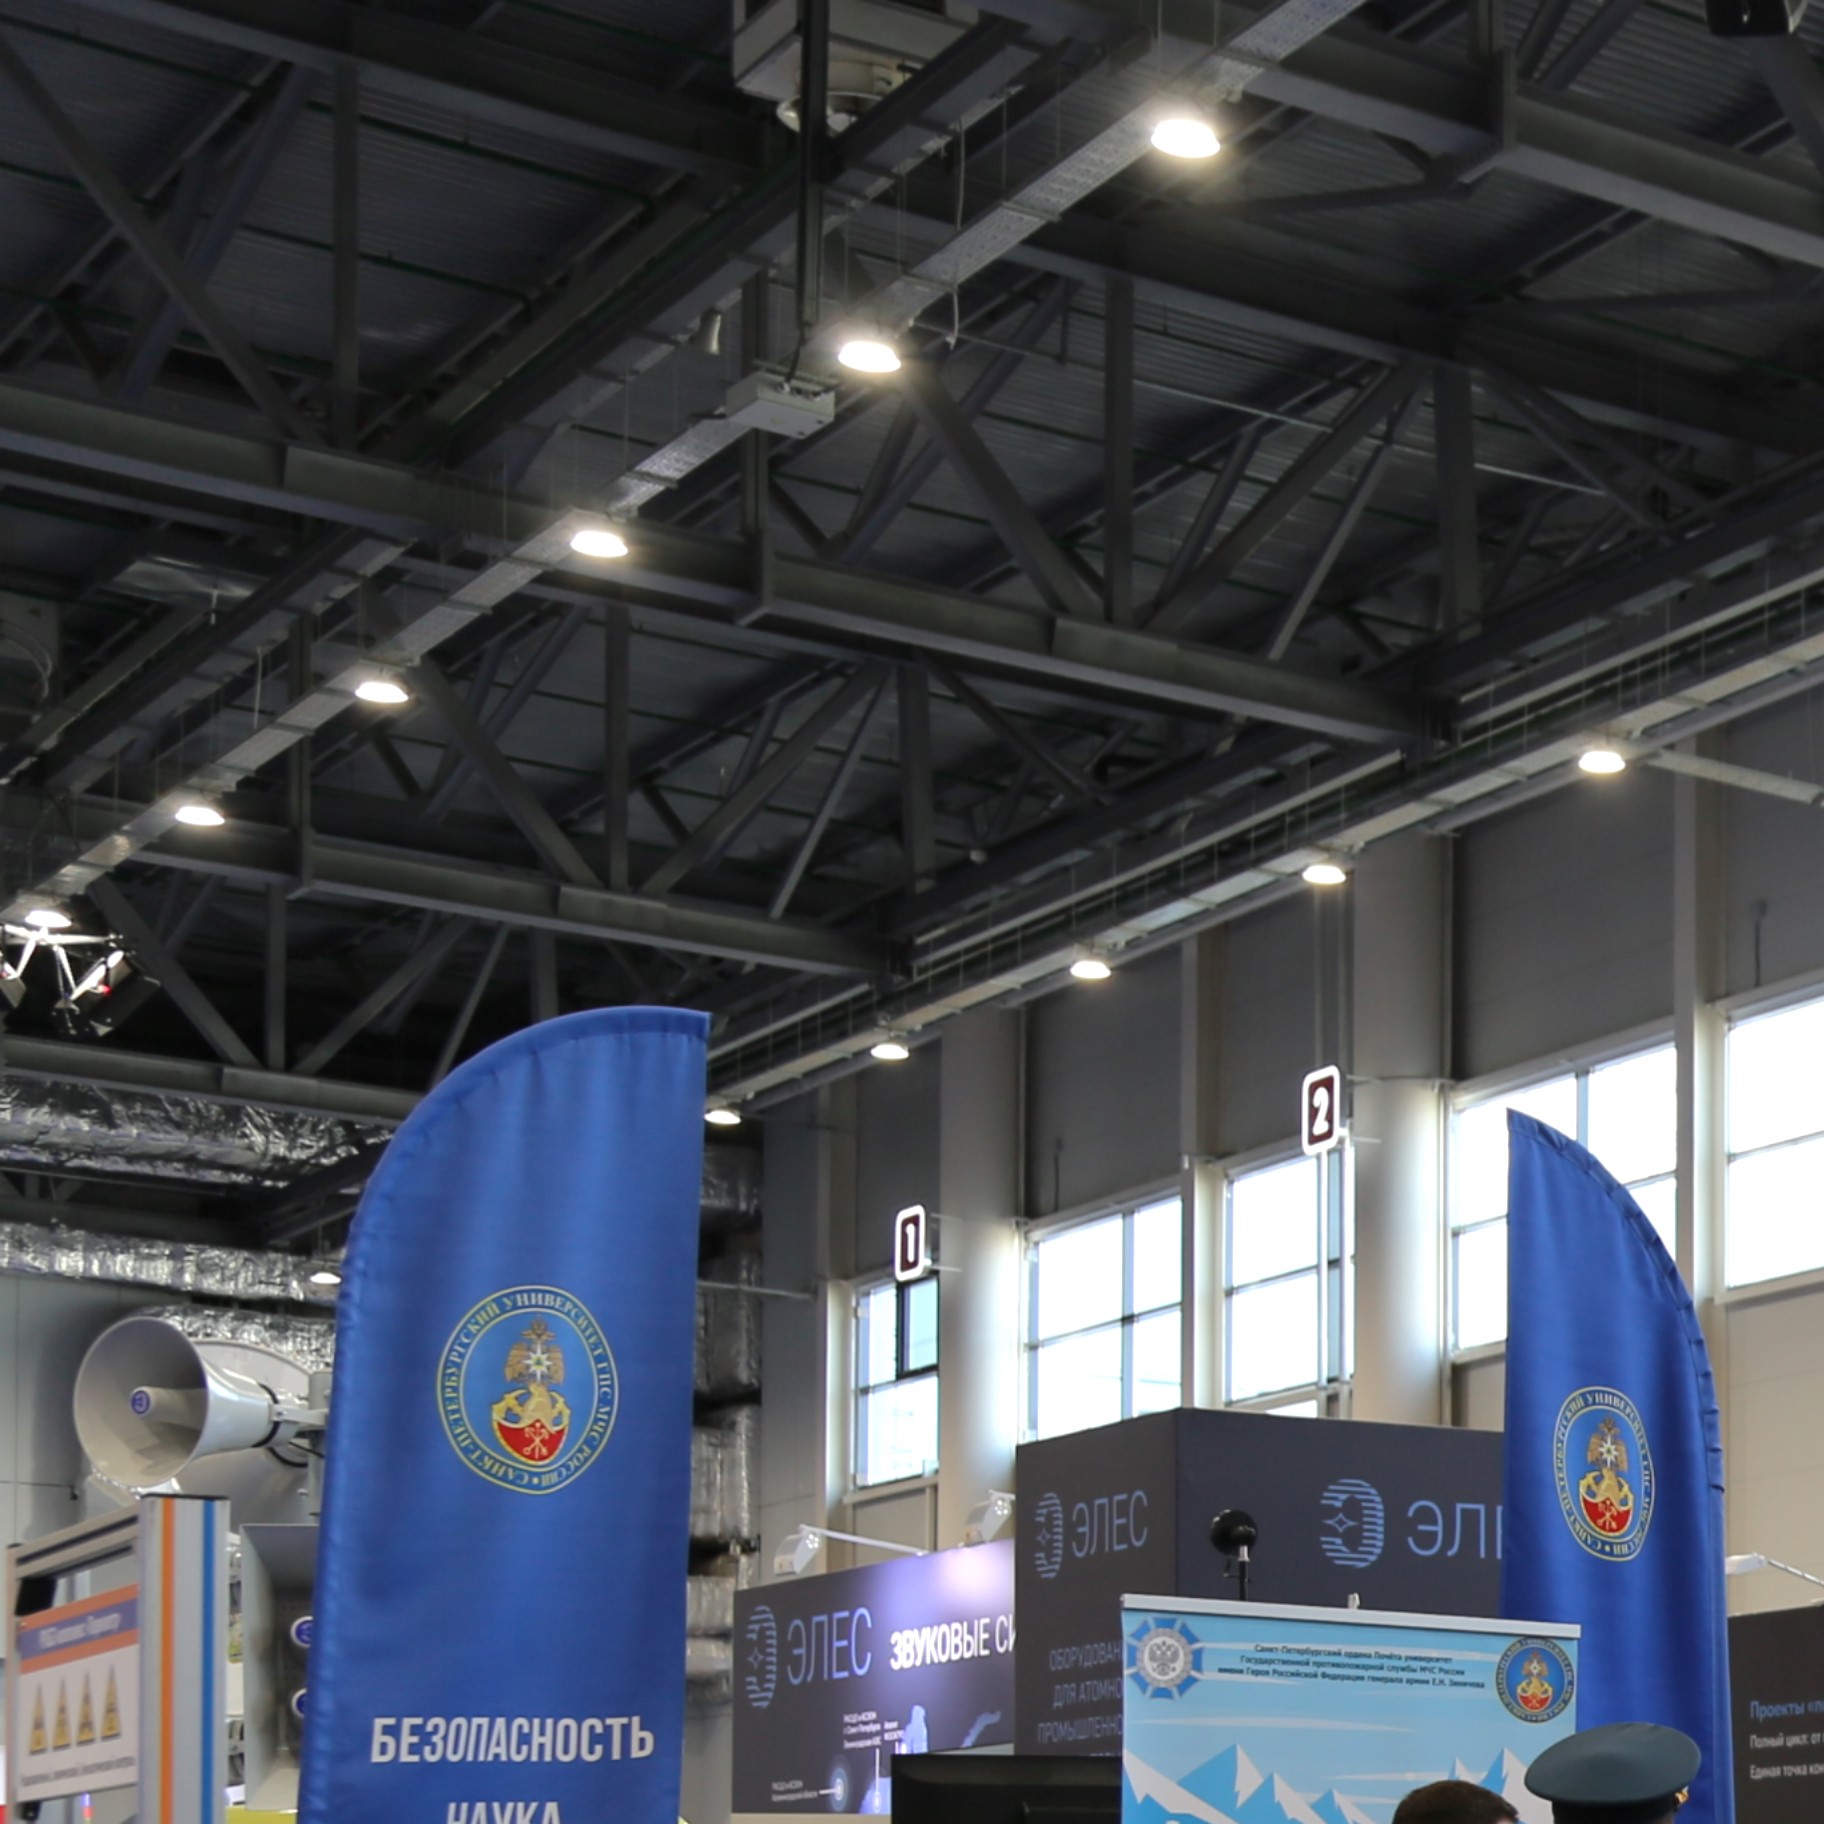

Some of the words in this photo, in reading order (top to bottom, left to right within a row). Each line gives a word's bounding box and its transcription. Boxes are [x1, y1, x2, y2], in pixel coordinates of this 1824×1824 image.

[1313, 1086, 1329, 1136] 2
[906, 1223, 915, 1263] 1
[1072, 1490, 1149, 1557] ЭЛЕС
[1406, 1500, 1503, 1559] ЭЛ
[787, 1607, 872, 1685] ЭЛЕС
[890, 1617, 991, 1670] ЗВУКОВЫЕ
[1240, 1655, 1310, 1669] Государственной
[1311, 1659, 1384, 1673] противопожарной
[1386, 1663, 1418, 1674] службы
[1254, 1644, 1342, 1658] Санкт-Петербургский
[1345, 1648, 1372, 1660] ордена
[1750, 1700, 1805, 1720] Проекты
[370, 1715, 655, 1763] БЕЗОПАСНОСТЬ
[1750, 1733, 1784, 1749] Полный
[1750, 1763, 1781, 1779] Единая
